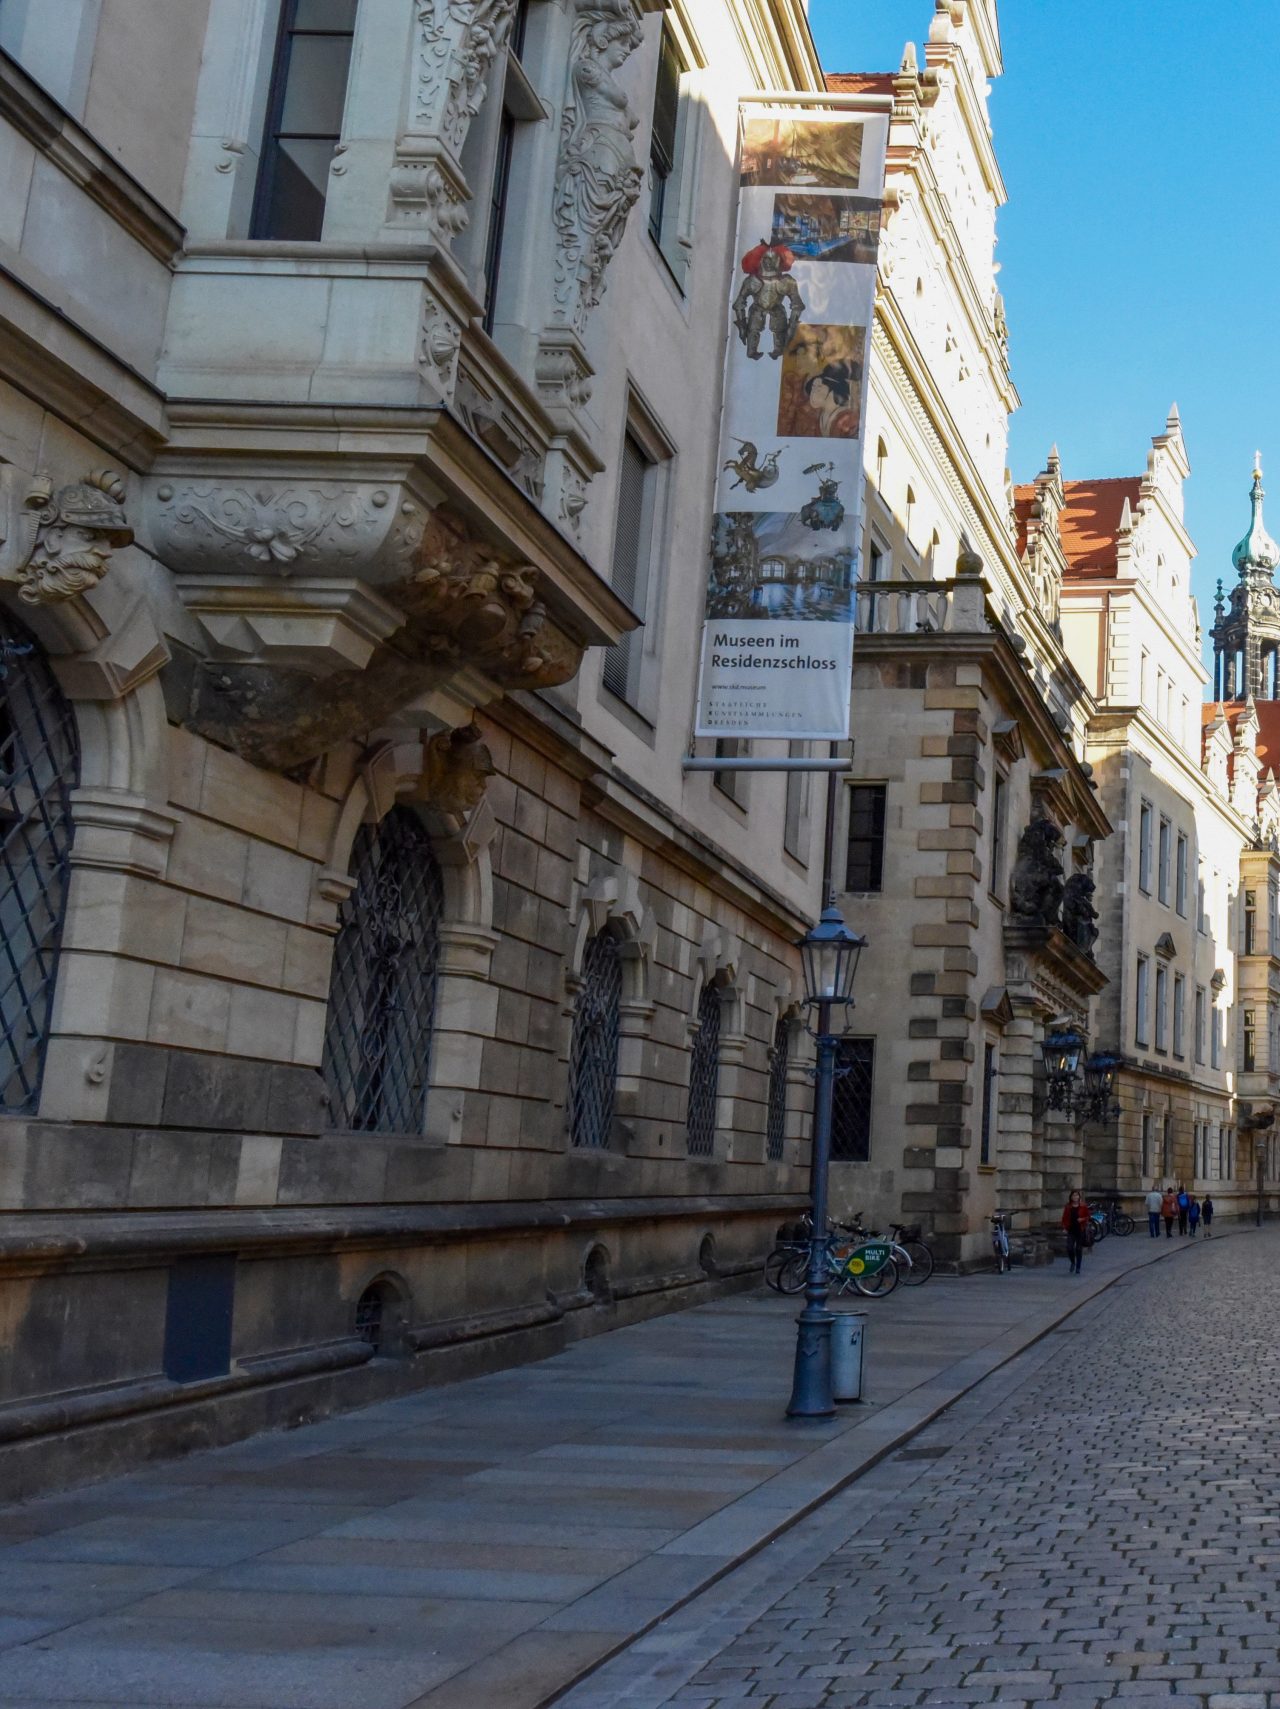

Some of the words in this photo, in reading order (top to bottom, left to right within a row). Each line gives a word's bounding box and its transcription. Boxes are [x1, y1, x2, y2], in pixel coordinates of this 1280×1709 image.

[713, 634, 775, 648] Museen
[779, 635, 800, 648] im
[711, 654, 837, 670] Residenzschloss
